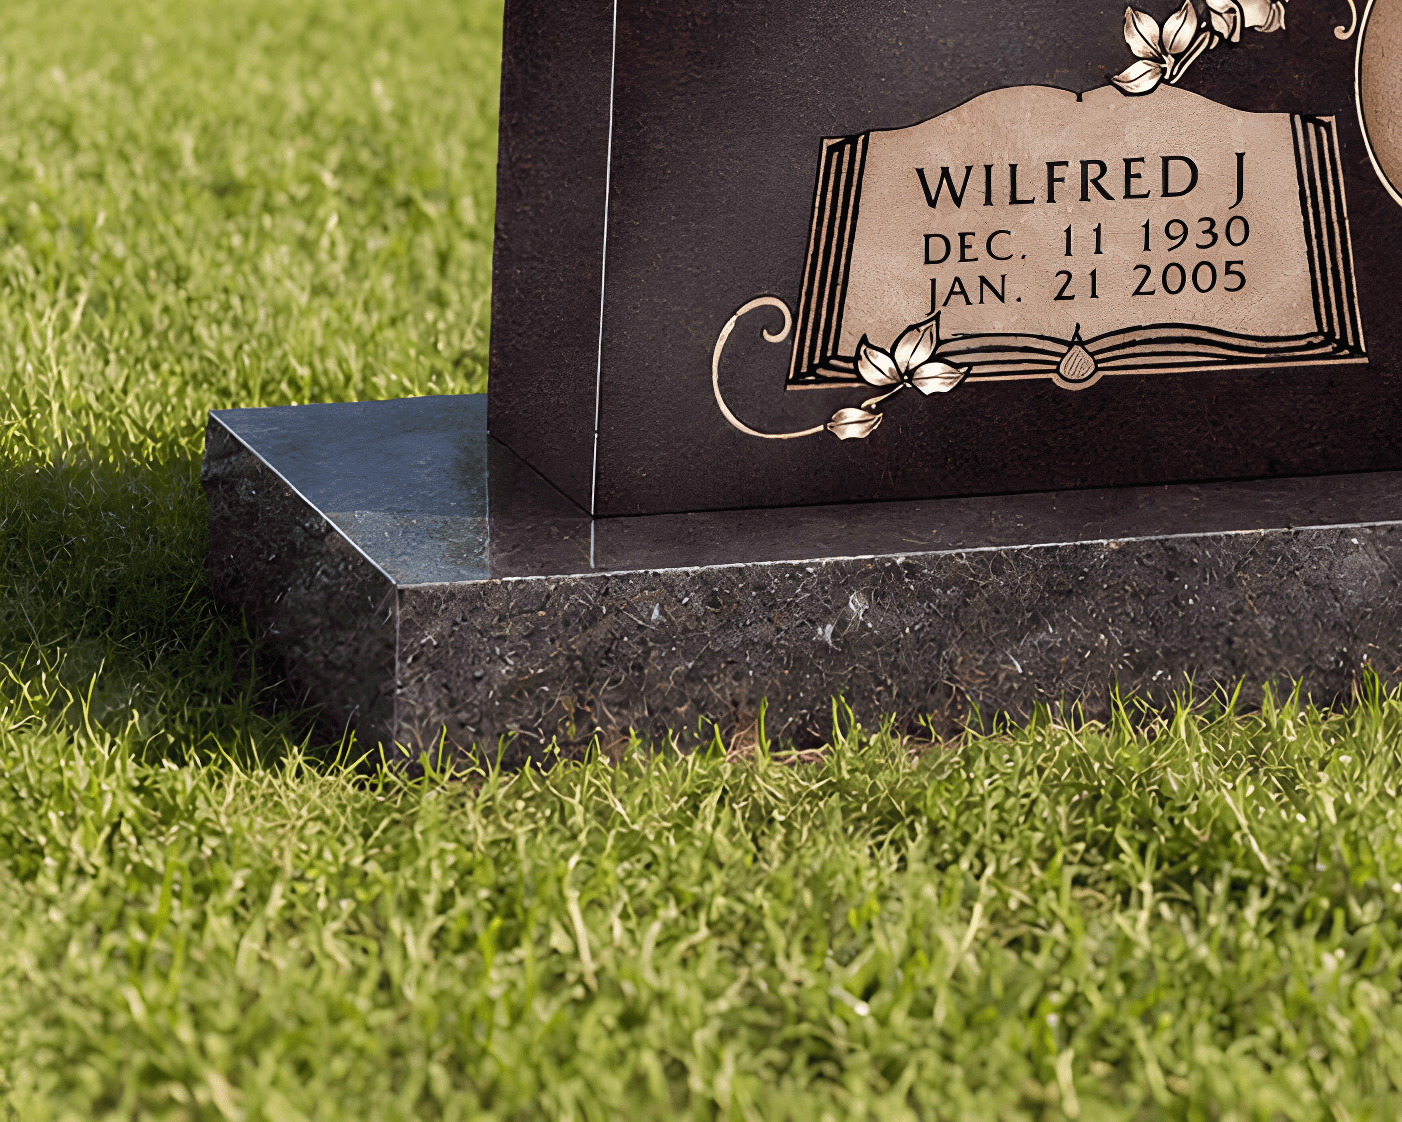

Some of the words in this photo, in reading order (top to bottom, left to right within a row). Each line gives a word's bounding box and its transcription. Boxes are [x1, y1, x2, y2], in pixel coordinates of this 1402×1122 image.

[914, 155, 1199, 210] WILFRED
[1228, 151, 1246, 210] J
[922, 229, 1027, 266] DEC.
[1063, 222, 1104, 257] 11
[1141, 215, 1250, 253] 1930
[925, 274, 1022, 317] JAN.
[1053, 267, 1100, 302] 21
[1131, 259, 1247, 297] 2005
